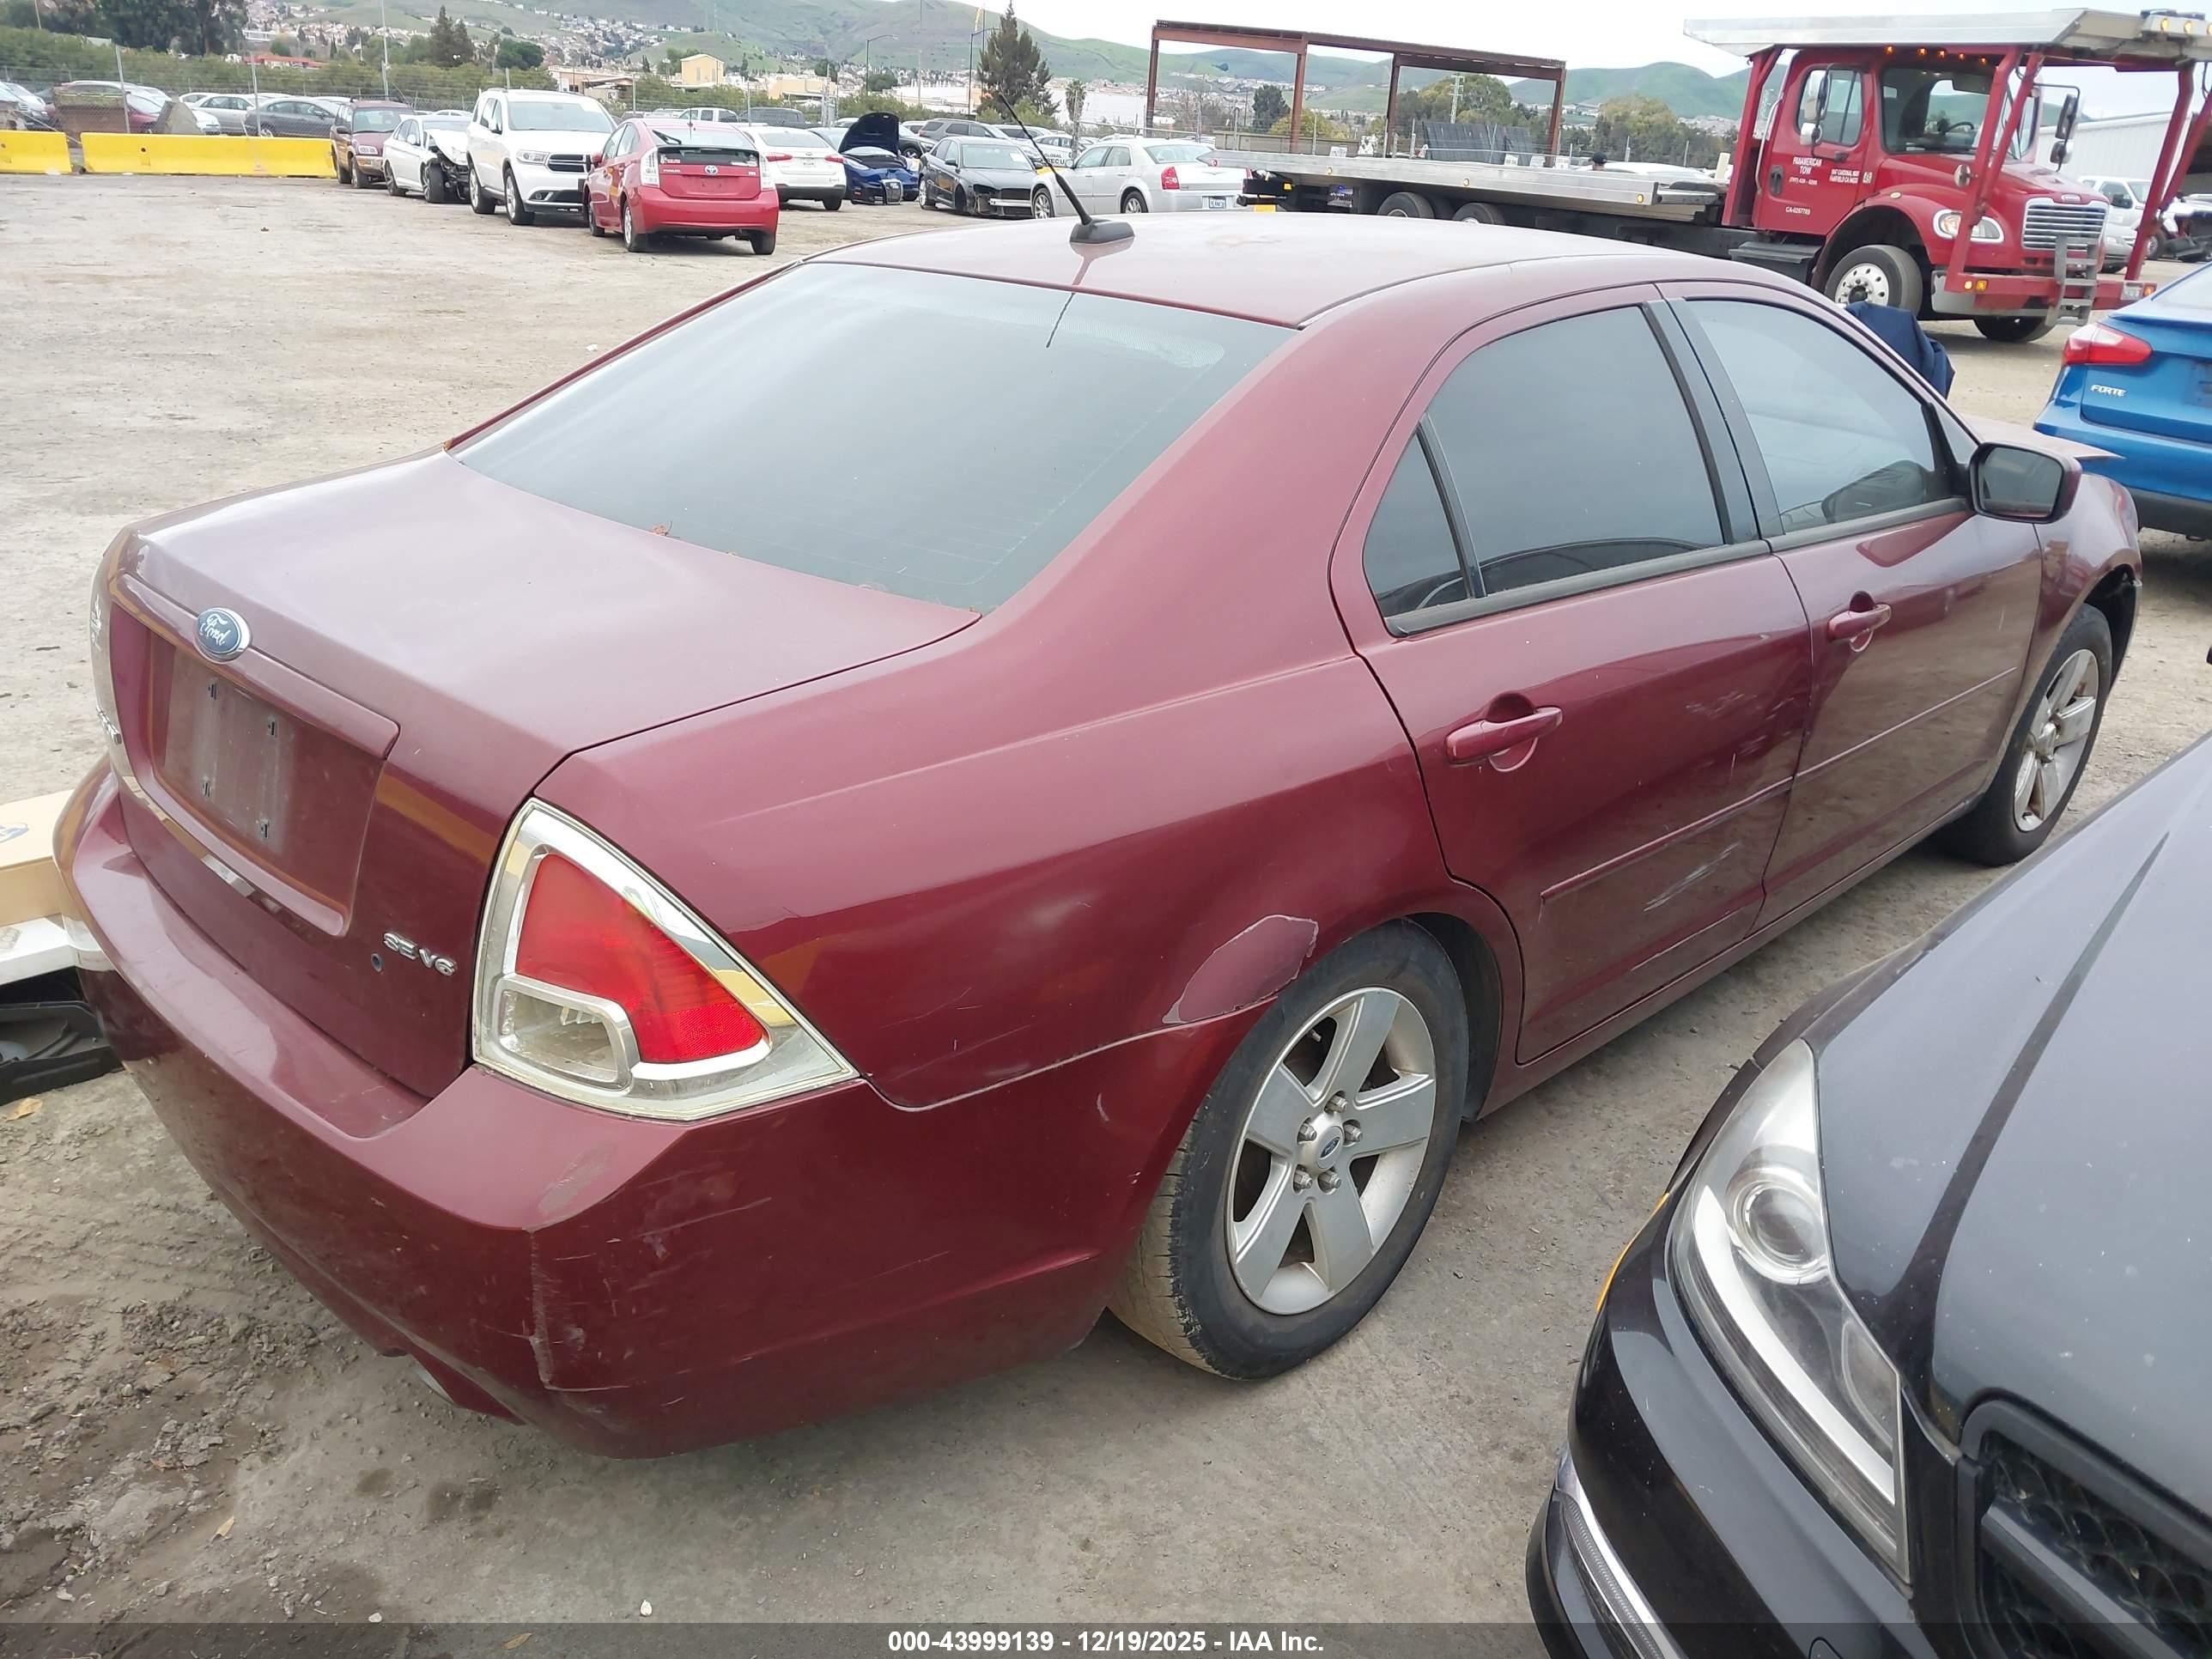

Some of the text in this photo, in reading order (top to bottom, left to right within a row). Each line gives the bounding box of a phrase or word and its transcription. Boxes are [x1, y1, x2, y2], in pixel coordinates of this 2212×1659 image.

[1793, 156, 1822, 167] PANAMERICAN
[1800, 166, 1812, 174] TOW
[2091, 385, 2127, 396] FORTE
[199, 613, 231, 646] Ford
[383, 933, 457, 976] SE V6
